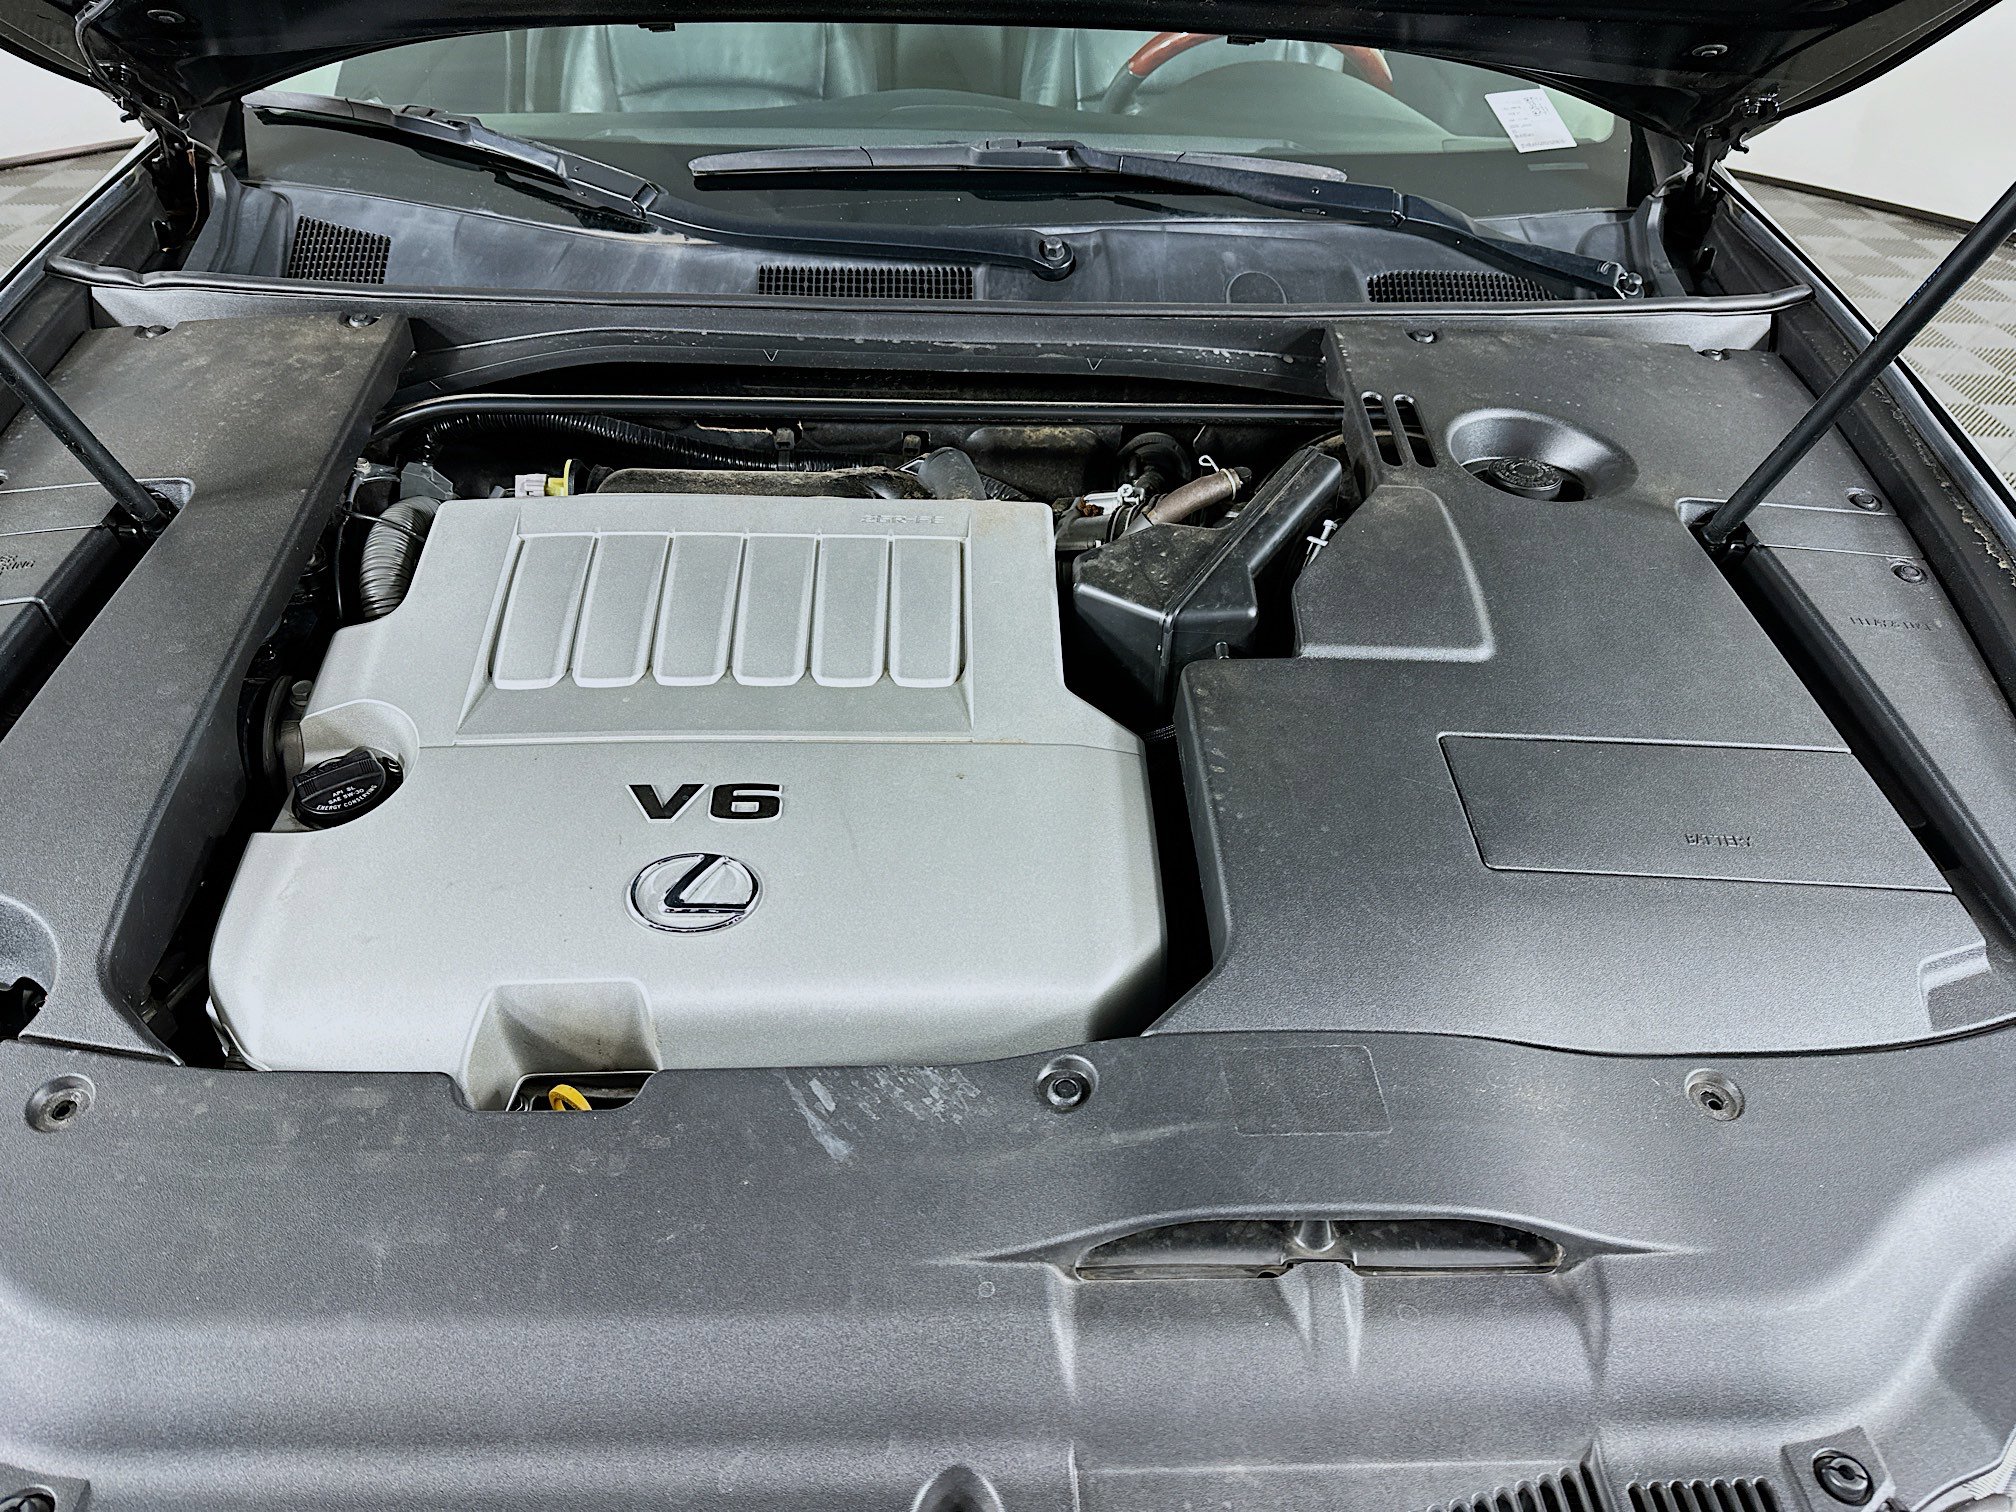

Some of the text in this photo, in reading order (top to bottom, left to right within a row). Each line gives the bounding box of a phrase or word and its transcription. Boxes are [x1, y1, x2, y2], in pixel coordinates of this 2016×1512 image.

[328, 788, 365, 805] SAE 5W-30
[332, 789, 344, 798] API
[343, 784, 378, 807] CONSERVING
[626, 783, 783, 824] V6
[1684, 833, 1752, 847] BATTERY
